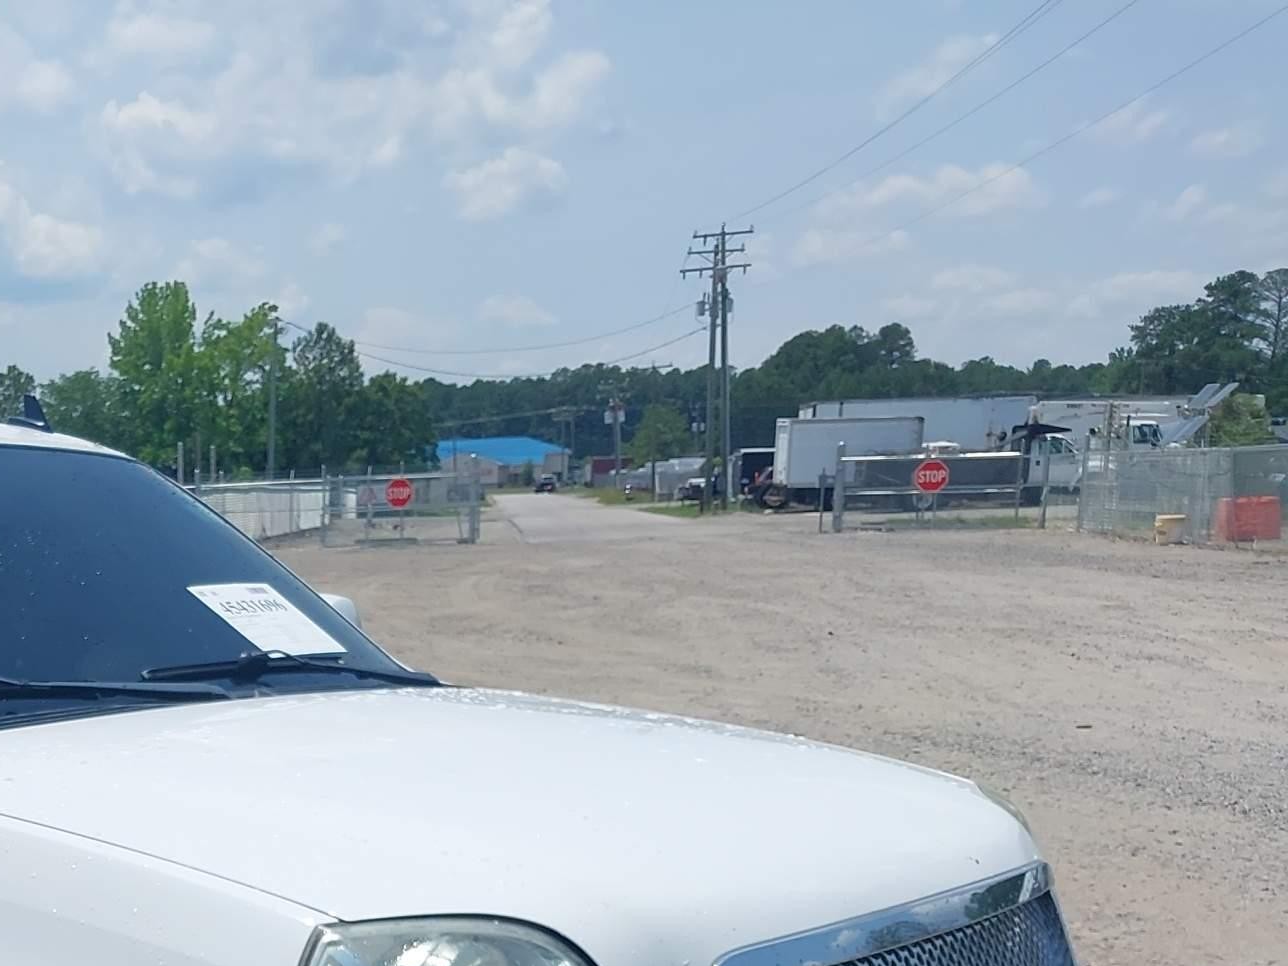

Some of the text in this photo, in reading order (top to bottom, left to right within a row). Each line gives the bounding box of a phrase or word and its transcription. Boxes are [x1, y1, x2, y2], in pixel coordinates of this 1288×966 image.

[918, 469, 946, 484] STOP
[386, 487, 411, 500] STOP
[218, 598, 289, 616] 45431696
